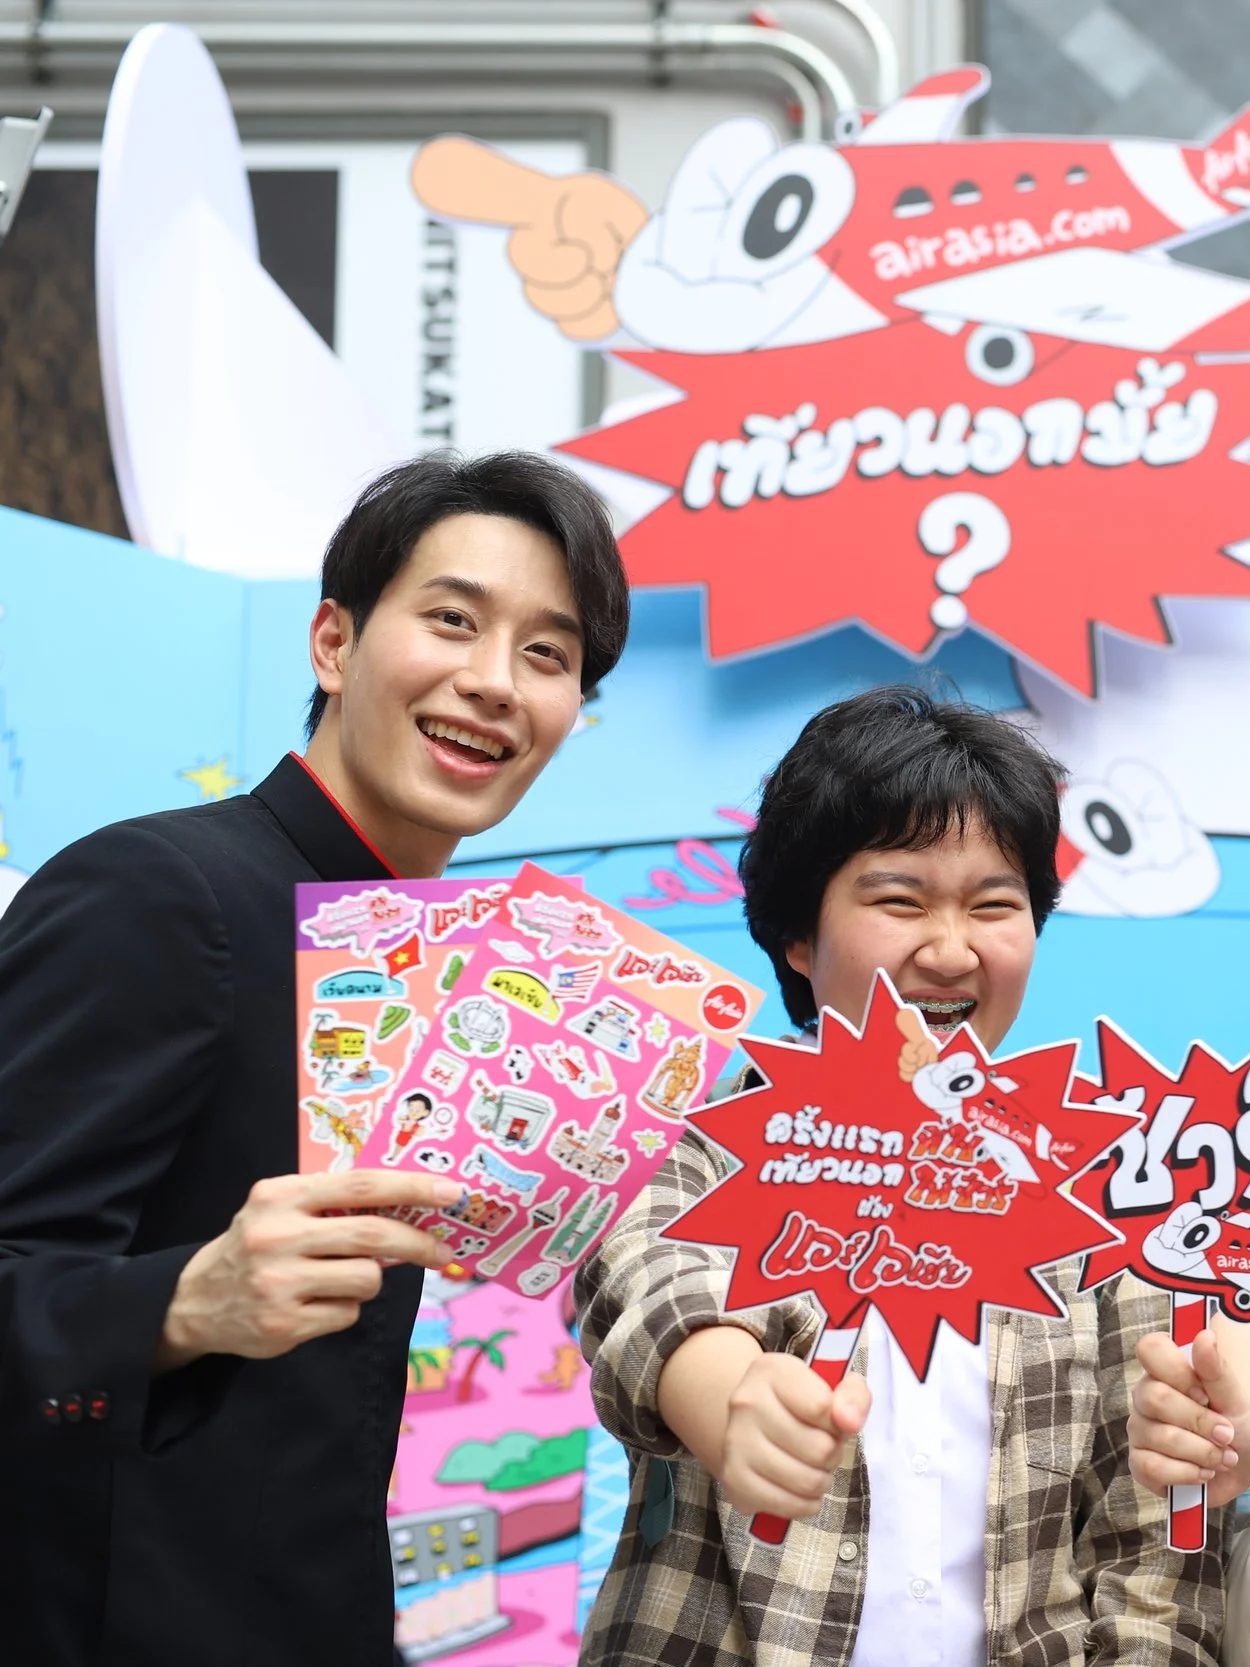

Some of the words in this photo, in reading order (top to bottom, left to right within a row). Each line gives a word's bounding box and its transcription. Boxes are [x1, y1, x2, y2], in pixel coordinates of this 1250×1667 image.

[870, 205, 1130, 281] airasia.com
[684, 357, 1218, 510] เที่ยวนอกมั้ย
[918, 491, 1012, 632] ?
[764, 1104, 905, 1157] ครั้งแรก
[758, 1152, 906, 1187] เที่ยวนอก
